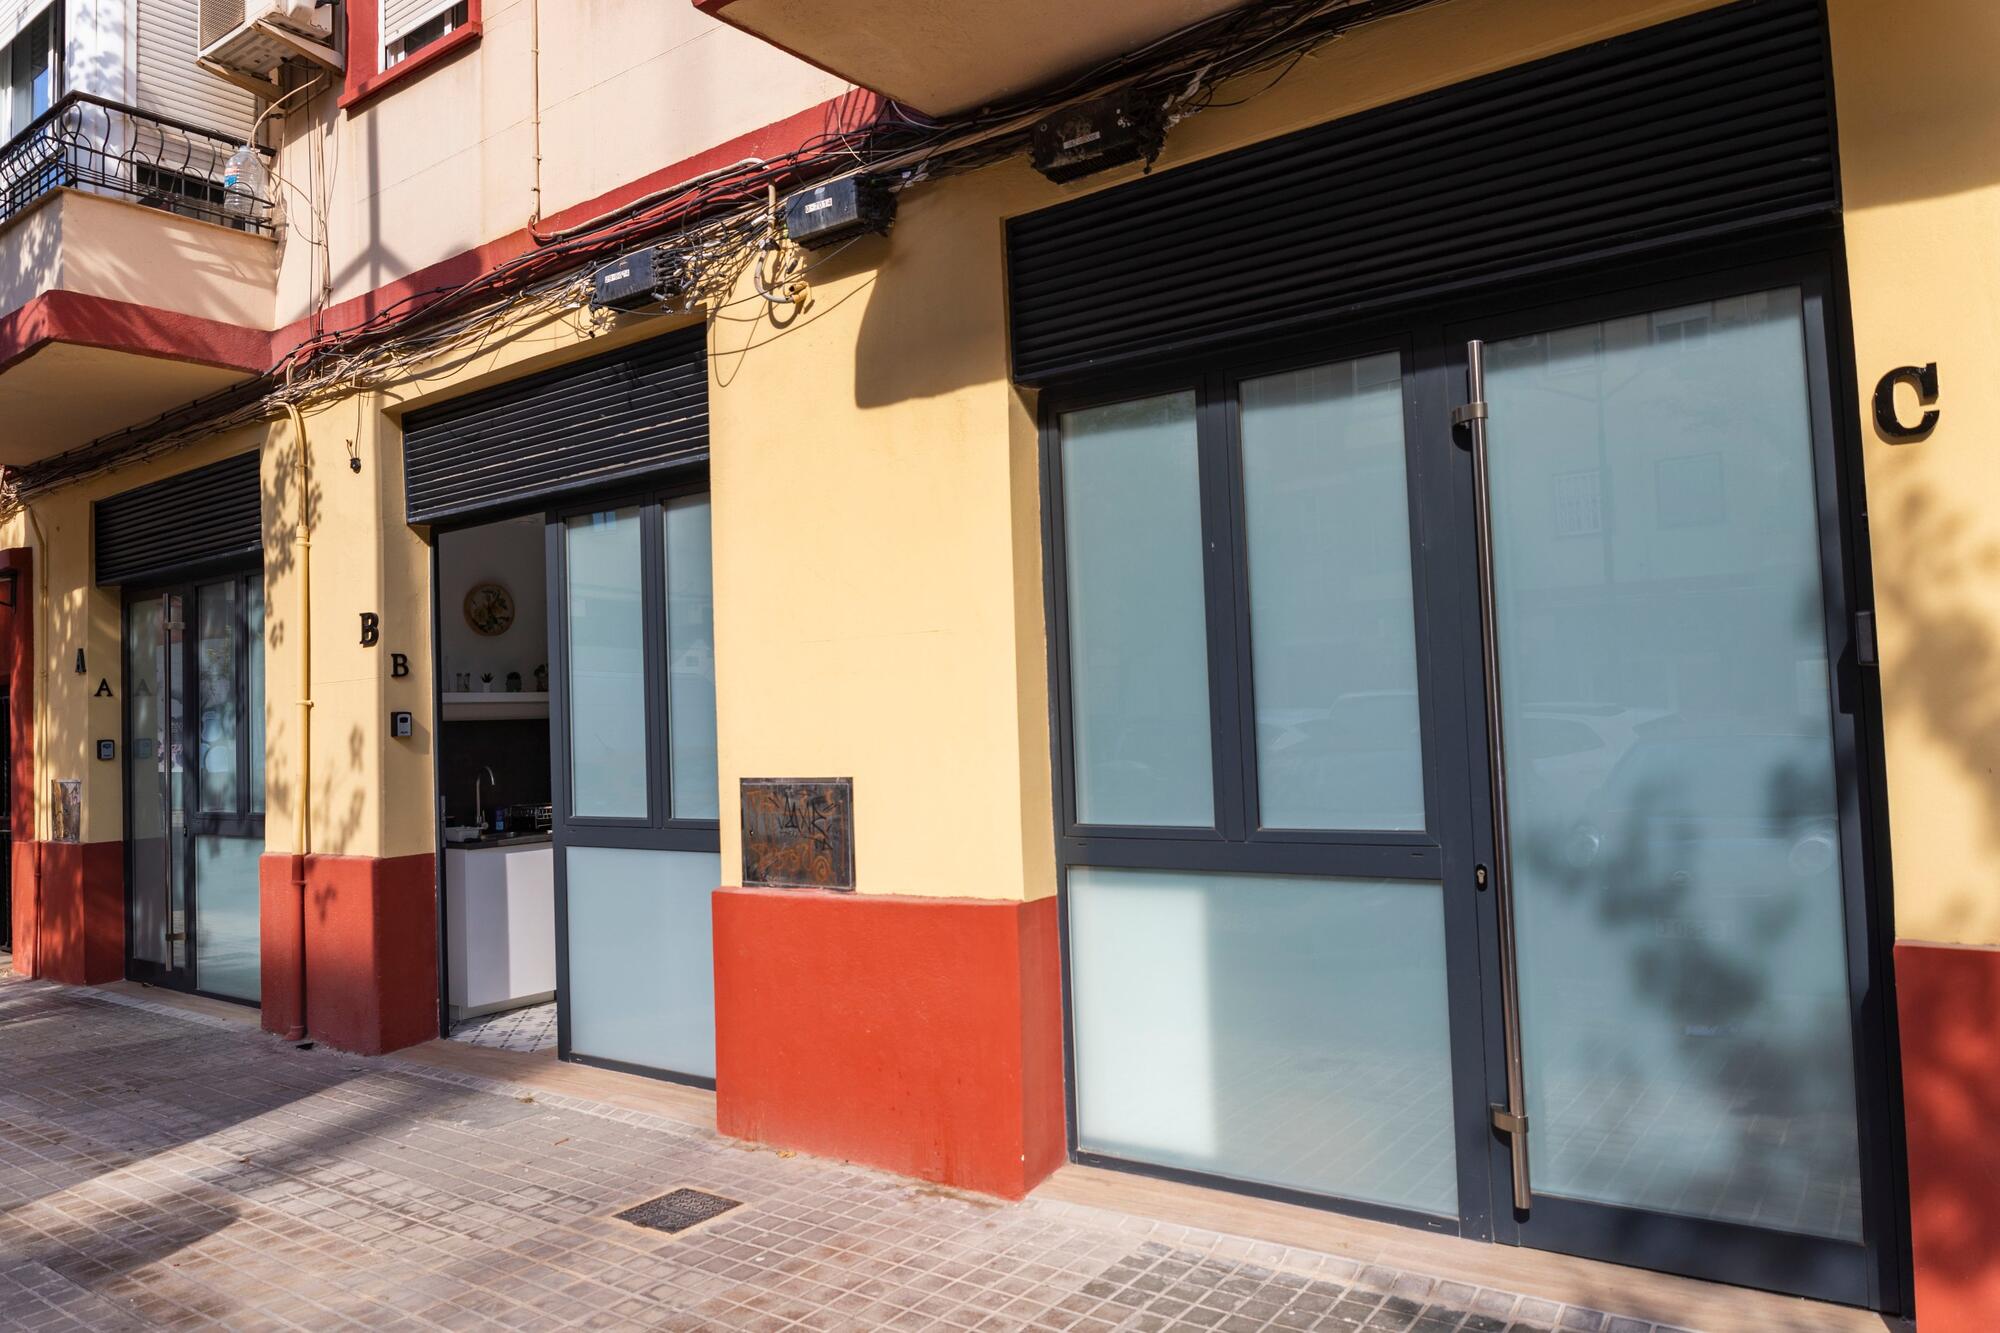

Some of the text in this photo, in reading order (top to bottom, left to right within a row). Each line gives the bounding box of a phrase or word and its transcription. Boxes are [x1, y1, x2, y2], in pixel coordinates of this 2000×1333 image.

[1872, 362, 1940, 442] C
[359, 612, 380, 646] B
[75, 647, 87, 673] A
[391, 653, 410, 678] B
[94, 678, 114, 697] A
